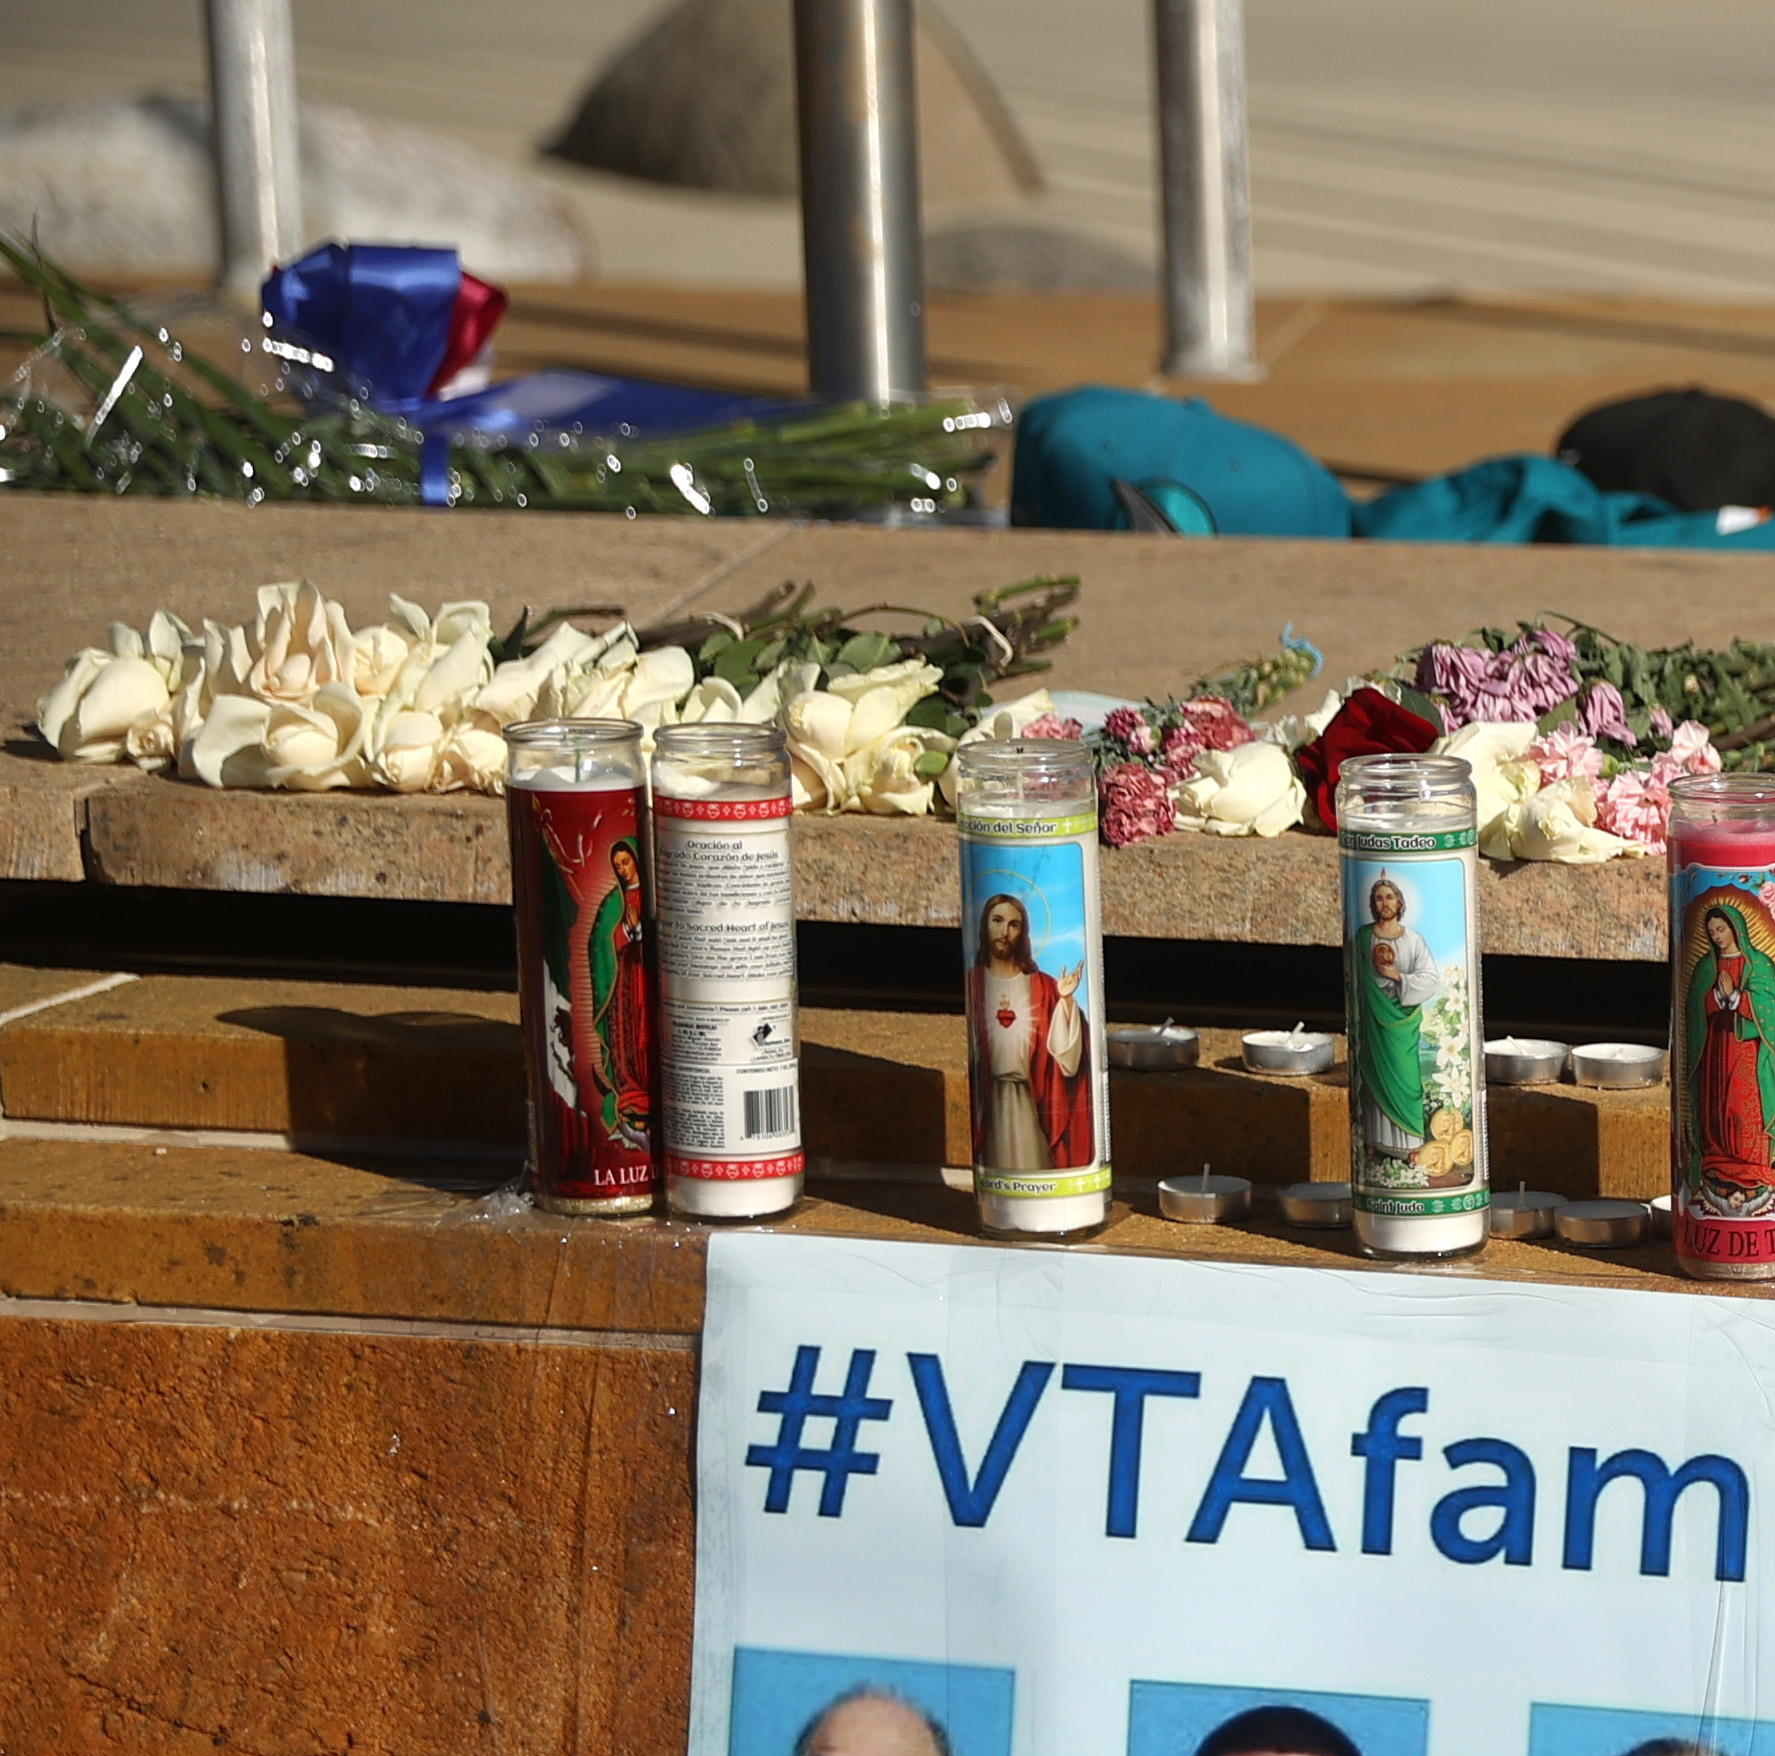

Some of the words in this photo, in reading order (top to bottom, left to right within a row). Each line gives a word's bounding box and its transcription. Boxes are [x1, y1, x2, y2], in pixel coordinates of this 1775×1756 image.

[993, 821, 1013, 833] del
[1016, 821, 1056, 834] Señor
[732, 841, 743, 851] al
[1356, 834, 1390, 849] Judas
[1393, 835, 1436, 849] Tadeo
[741, 852, 755, 862] de
[687, 921, 724, 933] Sacred
[726, 921, 757, 933] Heart
[594, 1168, 617, 1186] LA
[619, 1165, 649, 1185] LUZ
[1012, 1181, 1056, 1195] Prayer
[1367, 1199, 1394, 1212] Saint
[1395, 1200, 1425, 1215] Jude
[1684, 1219, 1721, 1256] LUZ
[1727, 1230, 1760, 1258] DE
